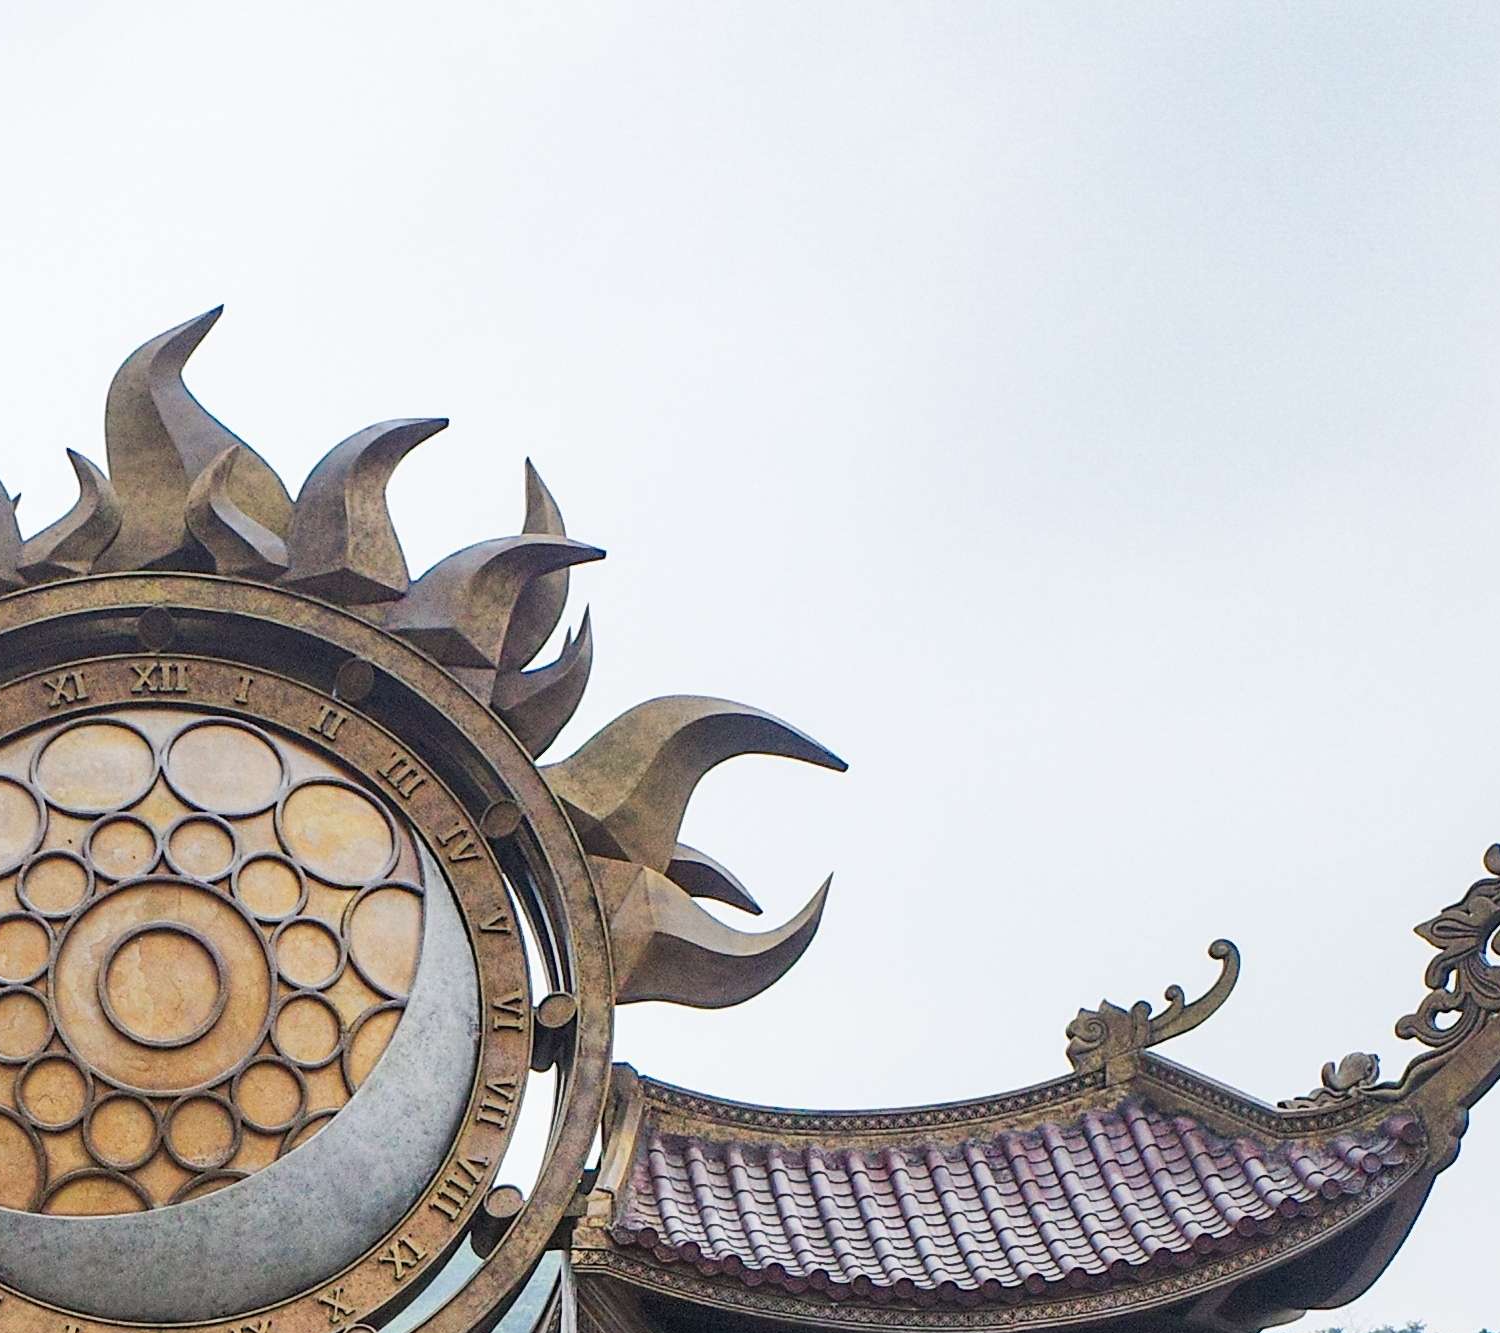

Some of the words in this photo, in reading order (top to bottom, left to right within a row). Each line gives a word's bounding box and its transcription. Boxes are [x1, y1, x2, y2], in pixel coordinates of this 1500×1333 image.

[44, 670, 88, 707] XI
[130, 663, 188, 693] XII
[233, 675, 253, 704] I
[310, 705, 347, 741] II
[377, 752, 425, 799] III
[436, 822, 482, 862] IV
[478, 907, 512, 934] V
[492, 988, 524, 1031] VI
[477, 1074, 517, 1129] VII
[430, 1157, 489, 1221] VIII
[379, 1234, 427, 1280] IX
[318, 1287, 355, 1324] X
